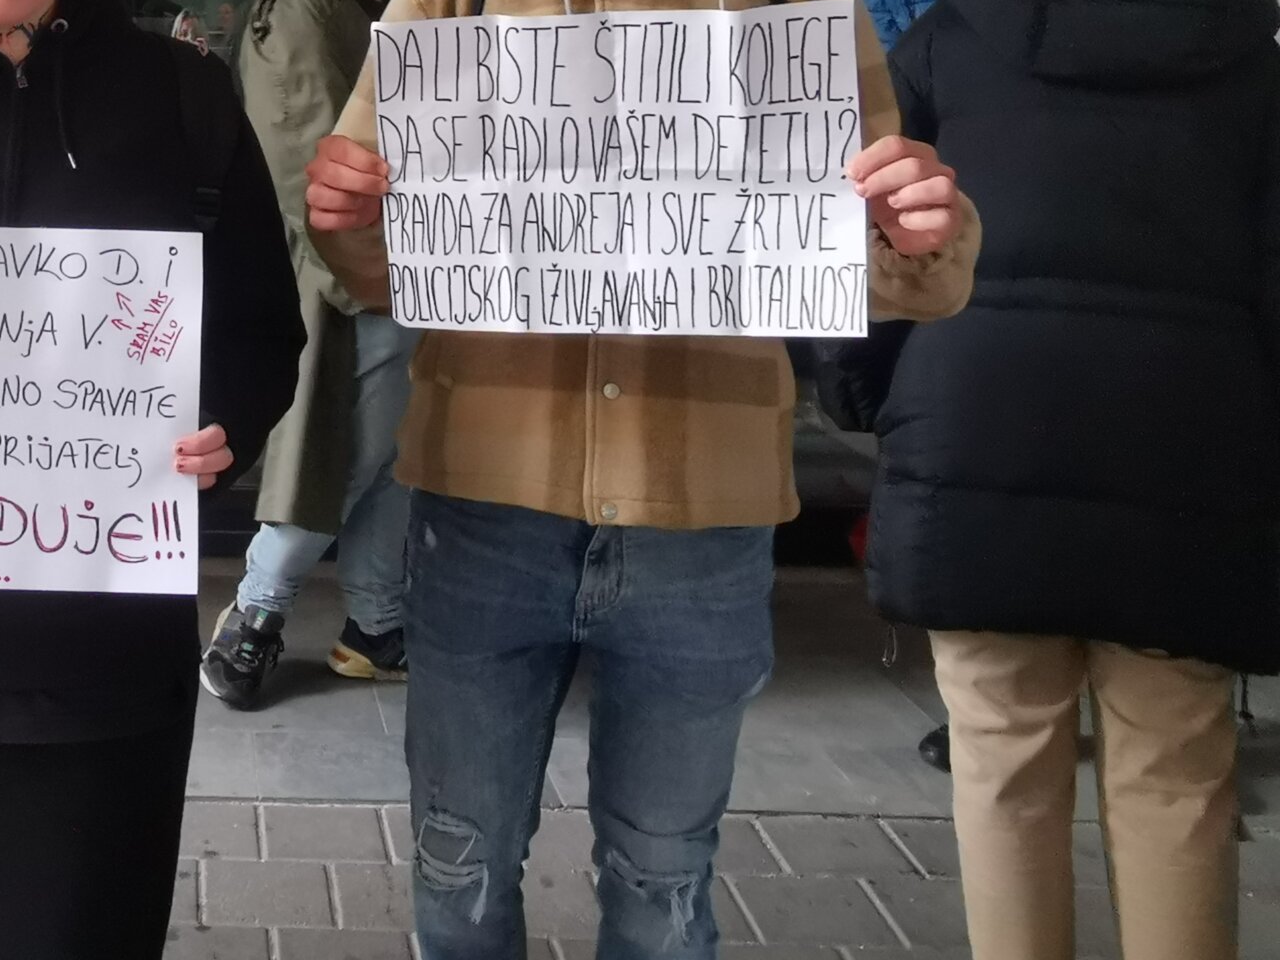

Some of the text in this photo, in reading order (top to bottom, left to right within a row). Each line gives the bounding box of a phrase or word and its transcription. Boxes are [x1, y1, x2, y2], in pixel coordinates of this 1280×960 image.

[373, 16, 855, 107] DA LI BISTE ŠTITILI KOLEGE,
[378, 110, 857, 184] DA SE RADI O VAŠEM DETETU?
[385, 188, 838, 256] PRAVDA ZA ANDREJA I SVE ŽRTVE
[99, 248, 144, 286] D.
[387, 264, 530, 330] POLICIJSKOG
[690, 266, 696, 329] I
[81, 314, 108, 349] V.
[127, 291, 168, 360] SRAM VAS
[54, 379, 177, 418] SPAVATE
